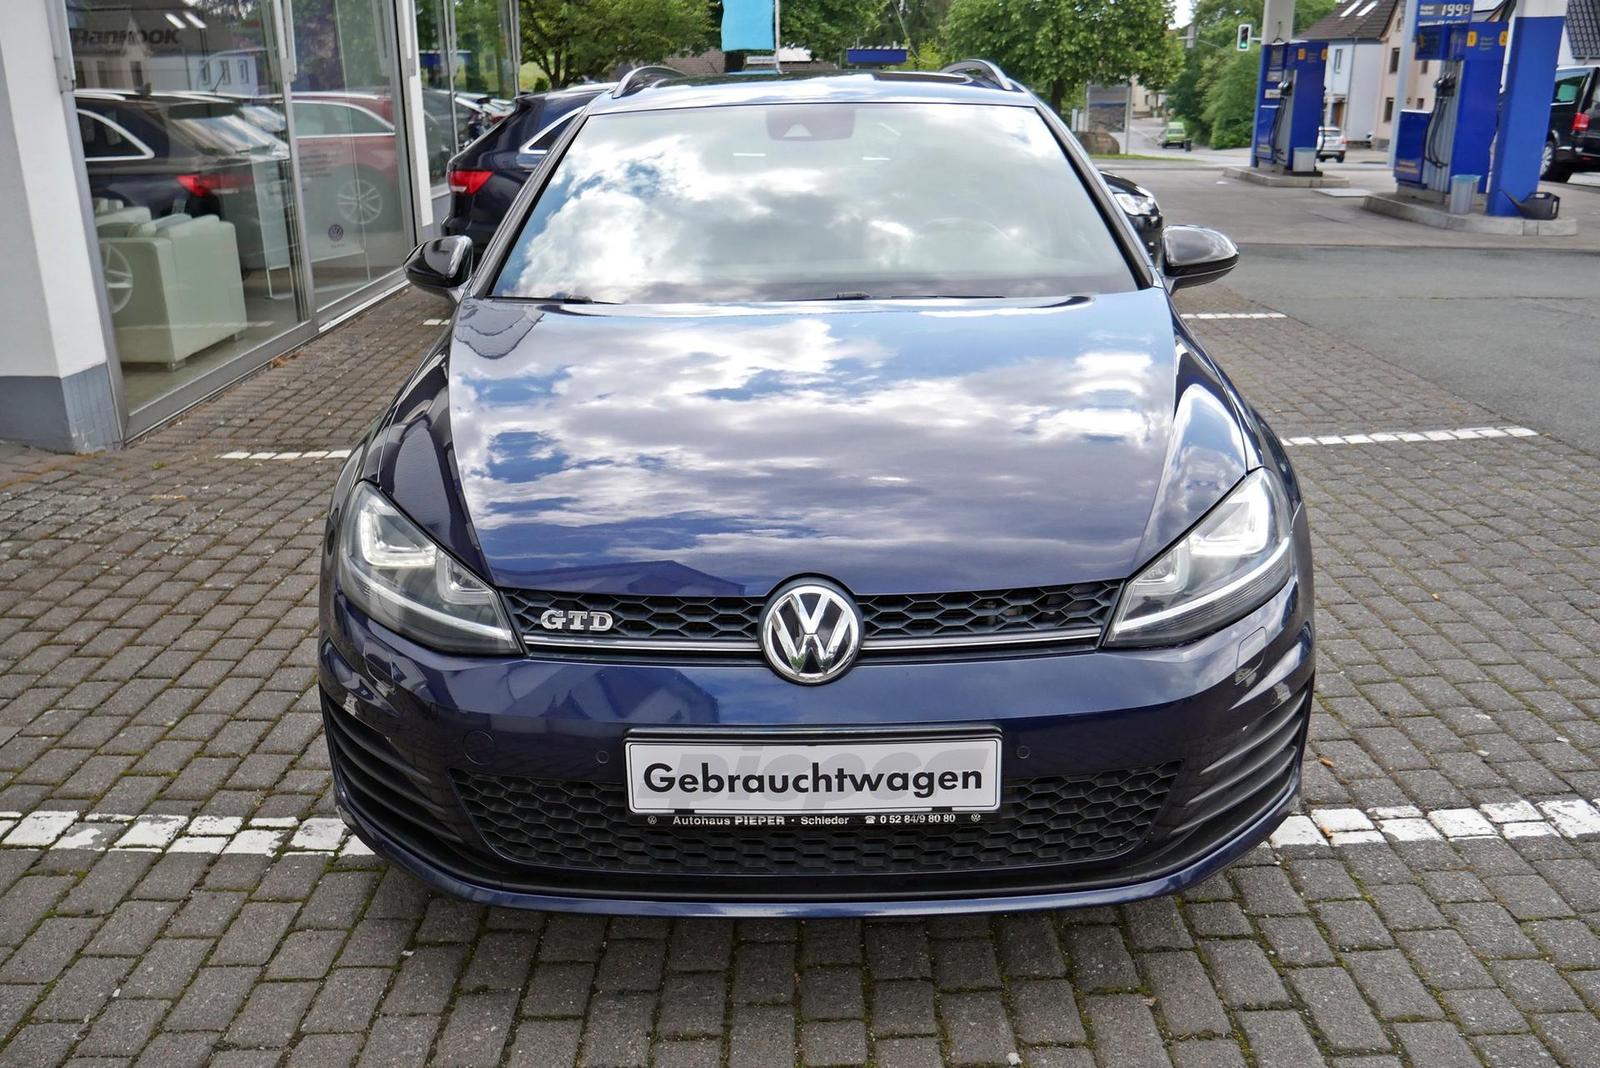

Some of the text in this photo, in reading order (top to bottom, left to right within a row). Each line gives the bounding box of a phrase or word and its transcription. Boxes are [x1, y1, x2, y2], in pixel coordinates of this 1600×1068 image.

[541, 609, 614, 632] GTD
[643, 762, 983, 798] Gebrauchtwagen
[672, 815, 731, 825] Autohaus
[734, 815, 786, 826] PIEPER
[800, 815, 850, 825] Schieder
[880, 815, 887, 824] 0
[889, 815, 901, 824] 52
[928, 814, 941, 823] 80
[943, 814, 956, 823] 80
